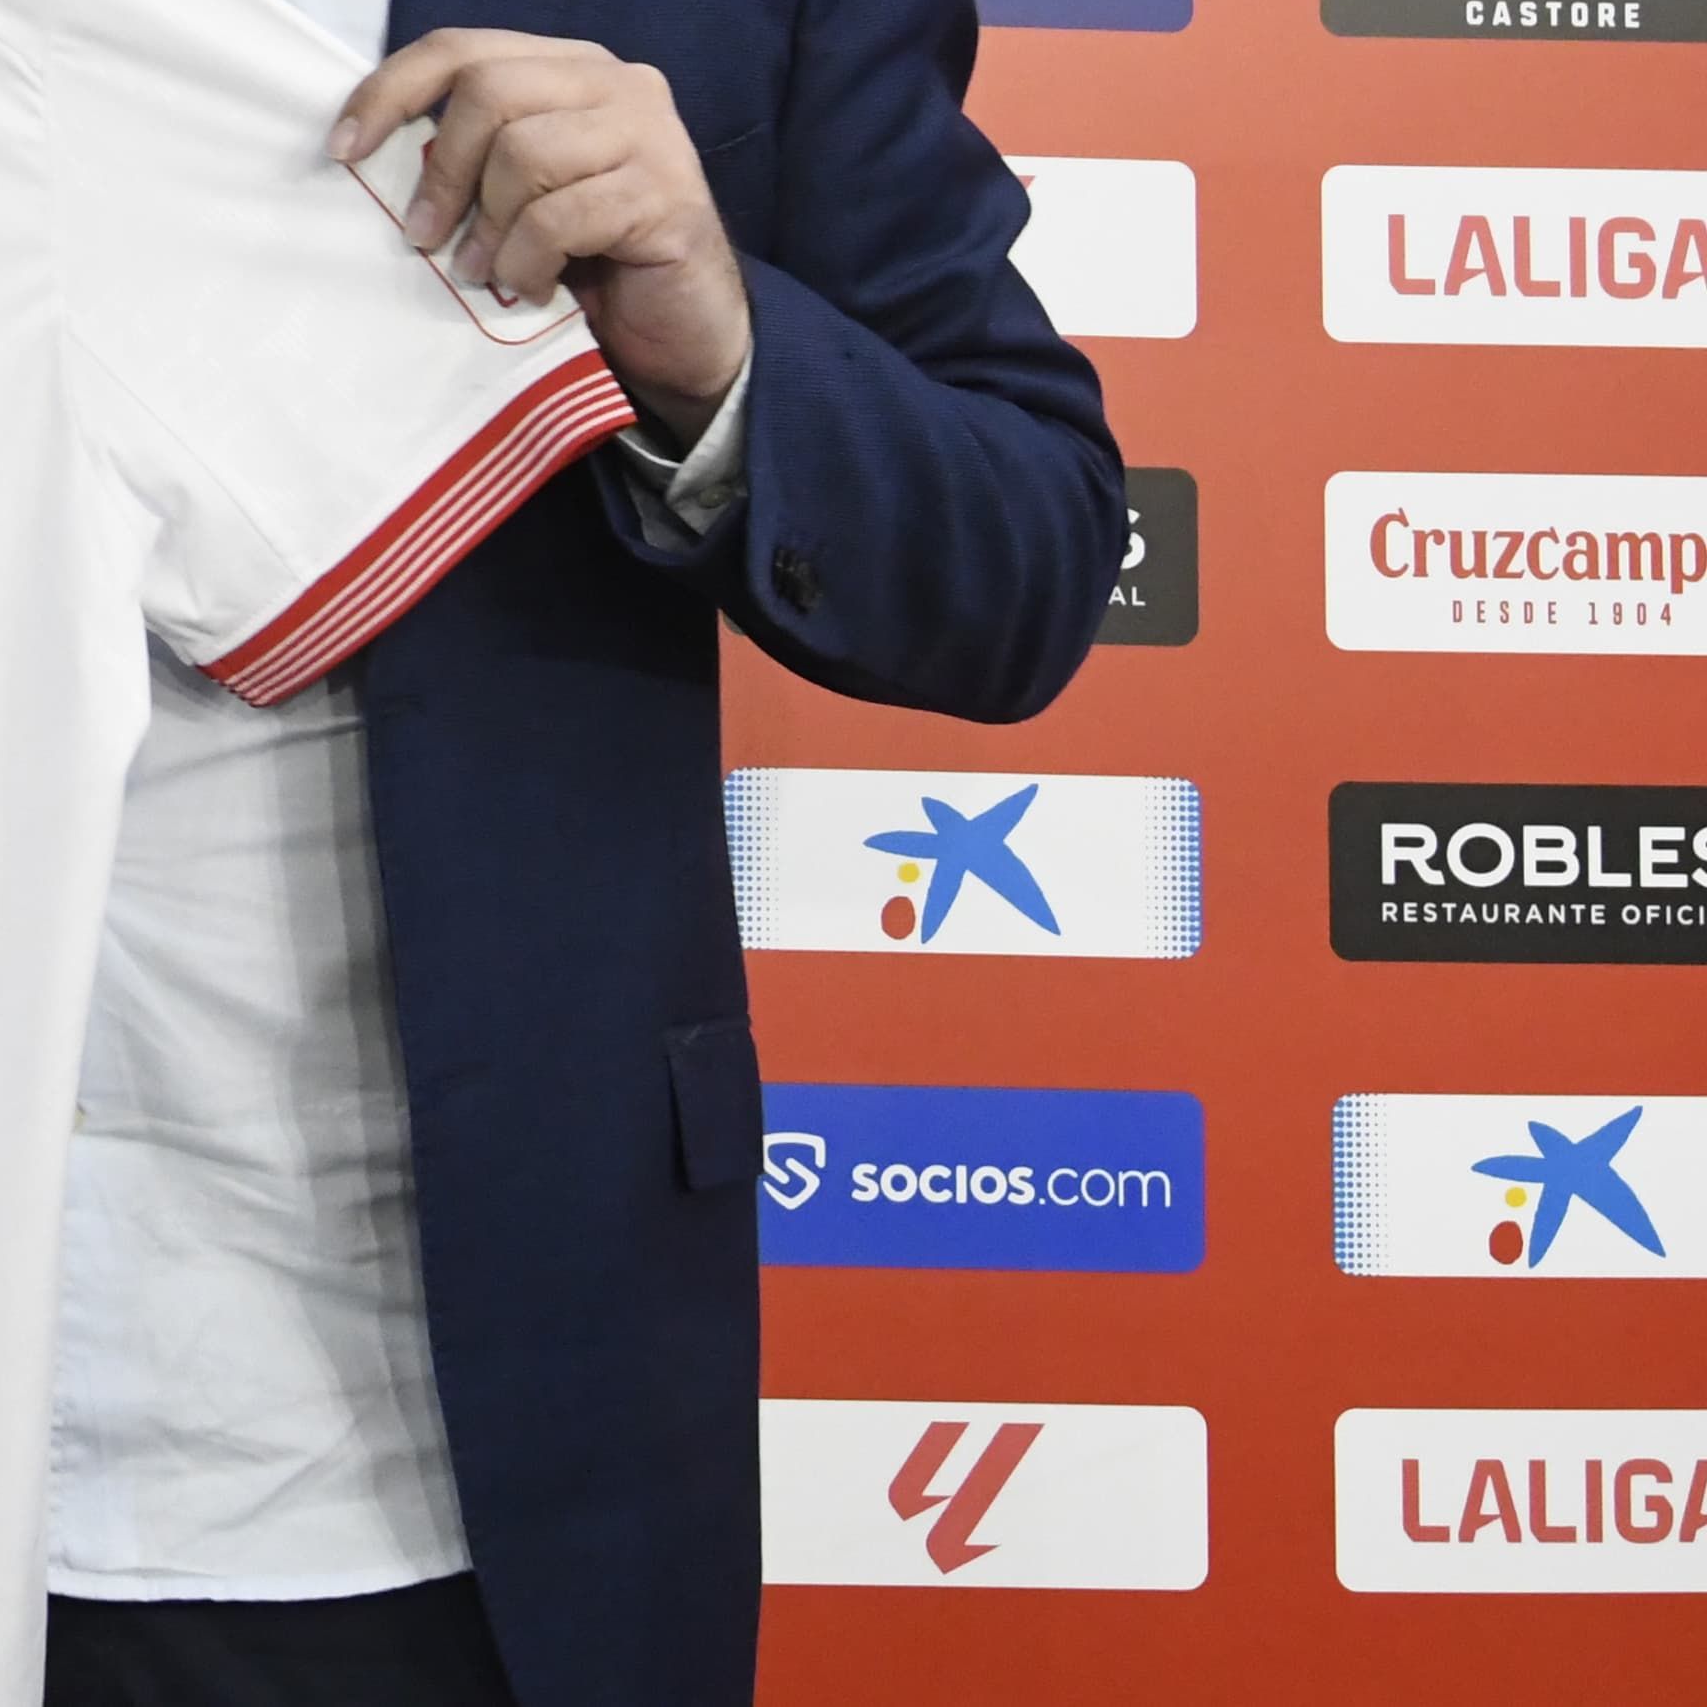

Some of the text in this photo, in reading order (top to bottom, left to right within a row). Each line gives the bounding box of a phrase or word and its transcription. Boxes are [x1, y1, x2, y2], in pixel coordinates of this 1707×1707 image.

[1465, 0, 1640, 29] CASTORE
[1388, 213, 1707, 300] LALIGA
[1369, 507, 1707, 595] Cruzcamp
[1452, 599, 1672, 626] DESDE 1904
[1381, 901, 1706, 926] RESTAURANTE OFICI
